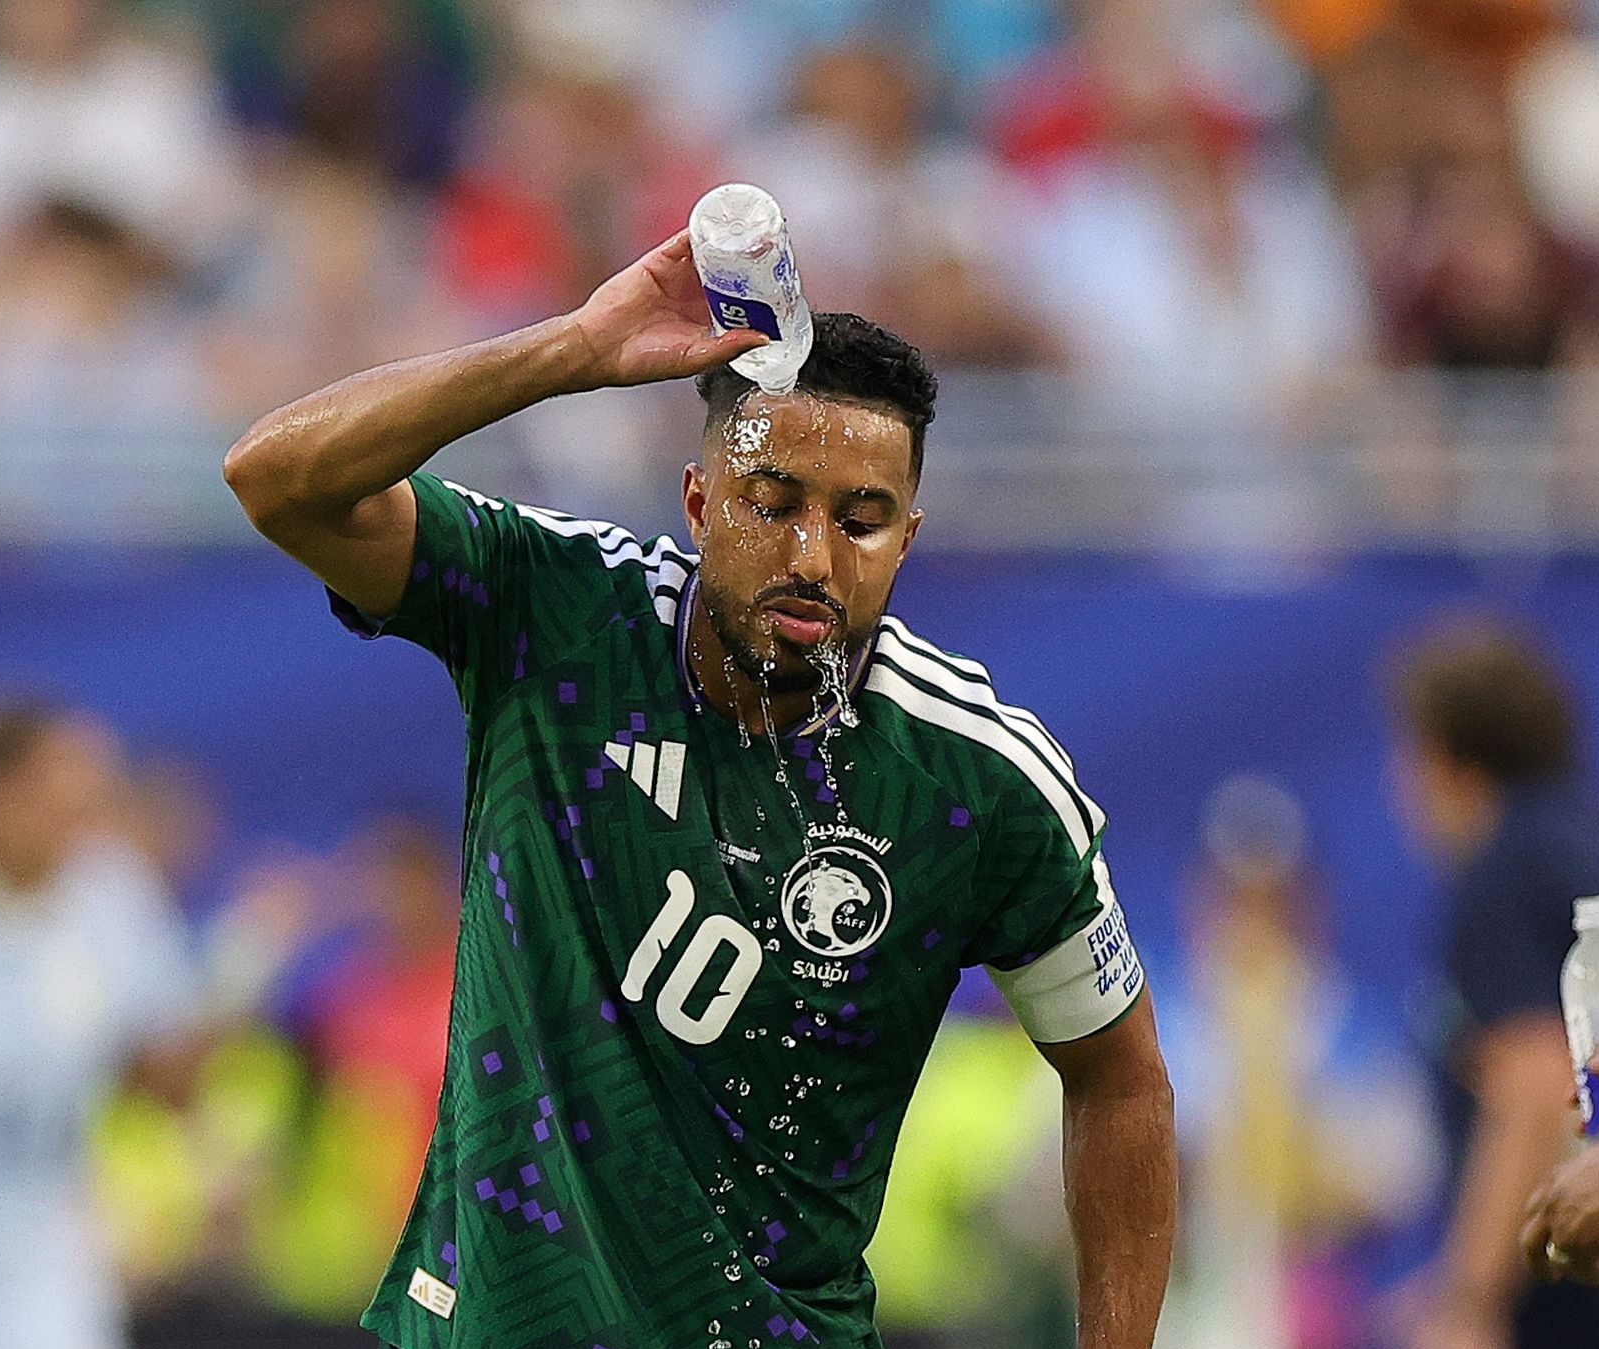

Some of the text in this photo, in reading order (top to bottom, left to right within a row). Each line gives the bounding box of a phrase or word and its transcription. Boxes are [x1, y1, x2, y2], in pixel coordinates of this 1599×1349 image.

[807, 821, 893, 856] السعودية
[835, 914, 867, 930] SAFF
[621, 869, 763, 1044] 10
[792, 960, 849, 983] SAUDI
[1094, 968, 1121, 996] the
